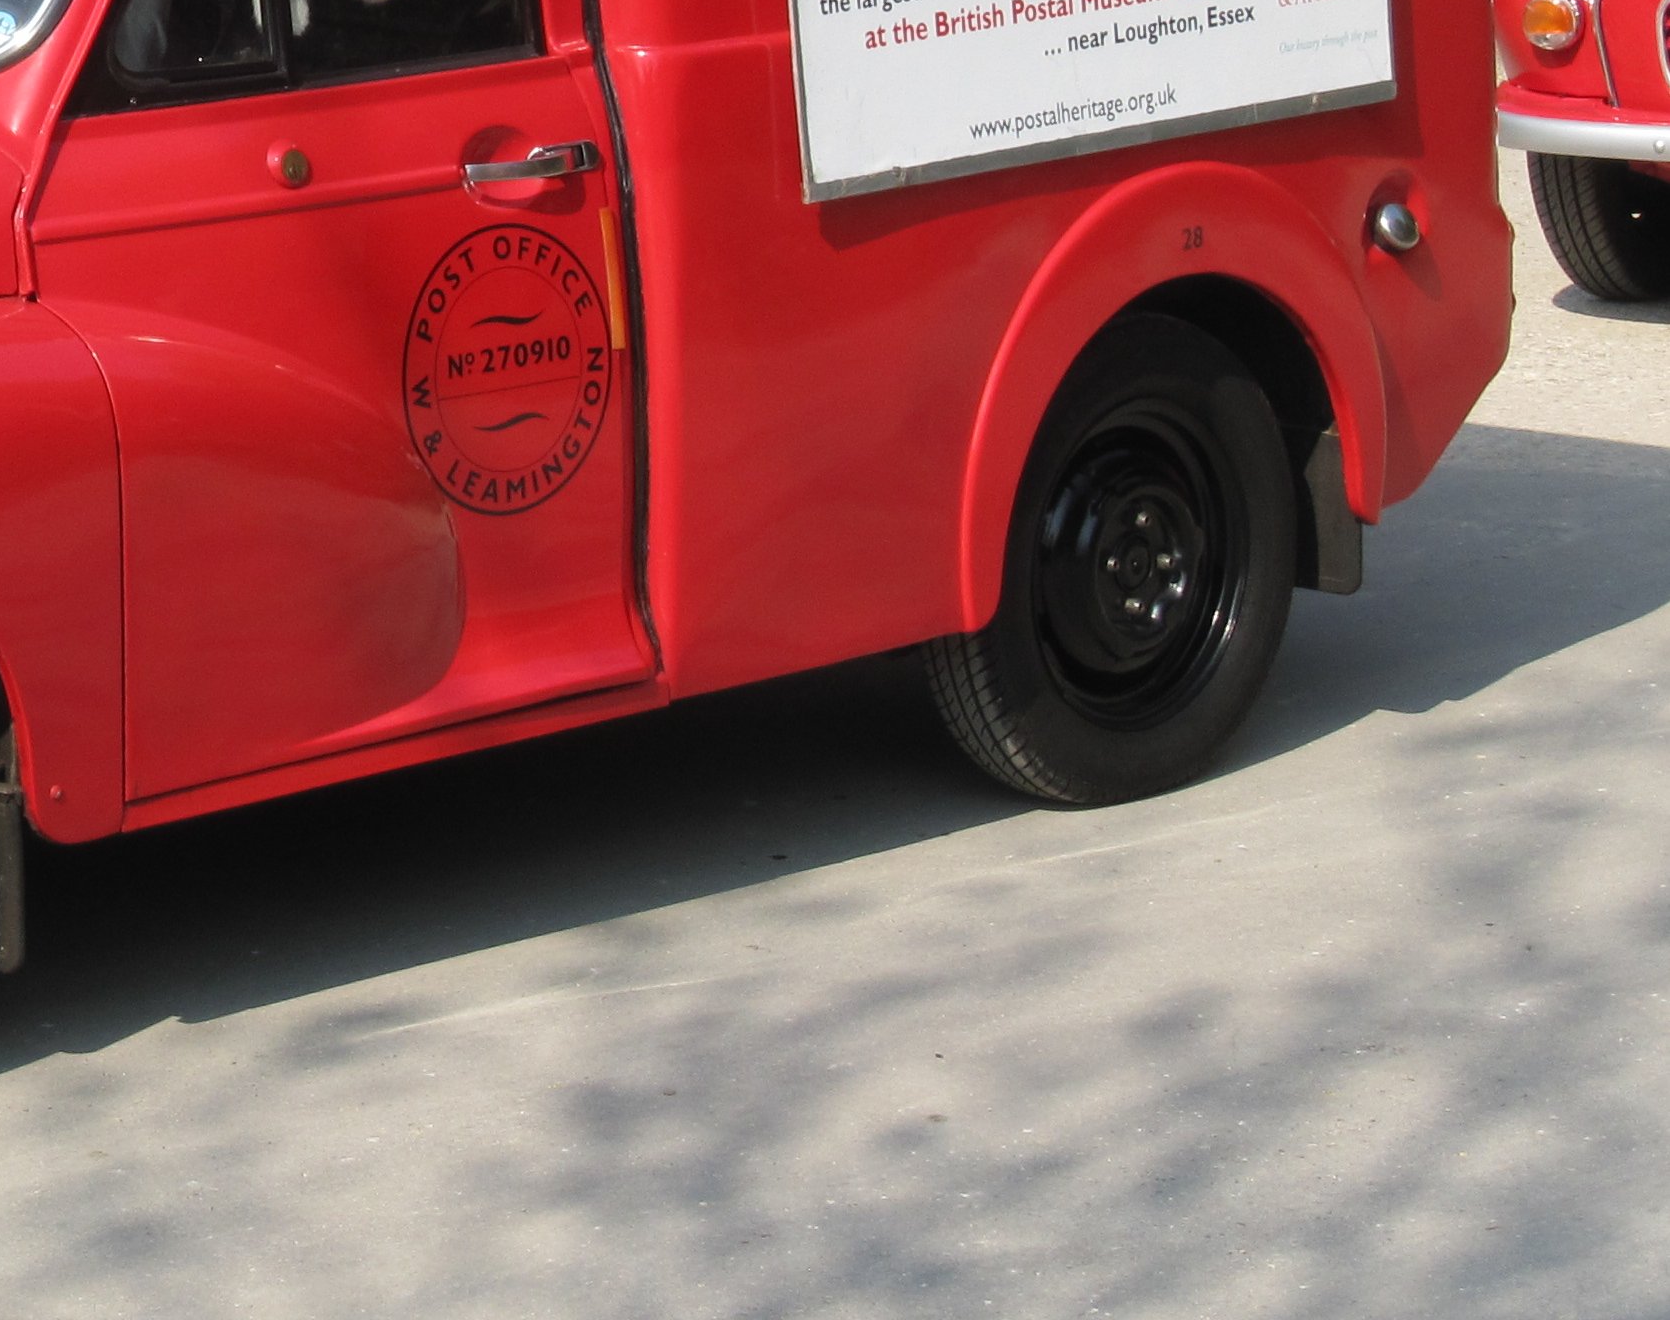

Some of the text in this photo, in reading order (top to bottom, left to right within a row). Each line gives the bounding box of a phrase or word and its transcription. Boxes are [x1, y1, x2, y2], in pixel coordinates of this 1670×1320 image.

[864, 24, 887, 50] at
[892, 16, 929, 45] the
[934, 2, 1005, 38] British
[1067, 29, 1109, 53] near
[1113, 14, 1204, 45] Loughton,
[1207, 5, 1255, 29] Essex
[968, 82, 1178, 140] www.postalheritage.org.uk
[1182, 226, 1203, 252] 28
[416, 234, 594, 344] POST OFFICE
[481, 335, 571, 374] 270910
[423, 430, 442, 458] &
[445, 346, 605, 504] LEAMINGTON
